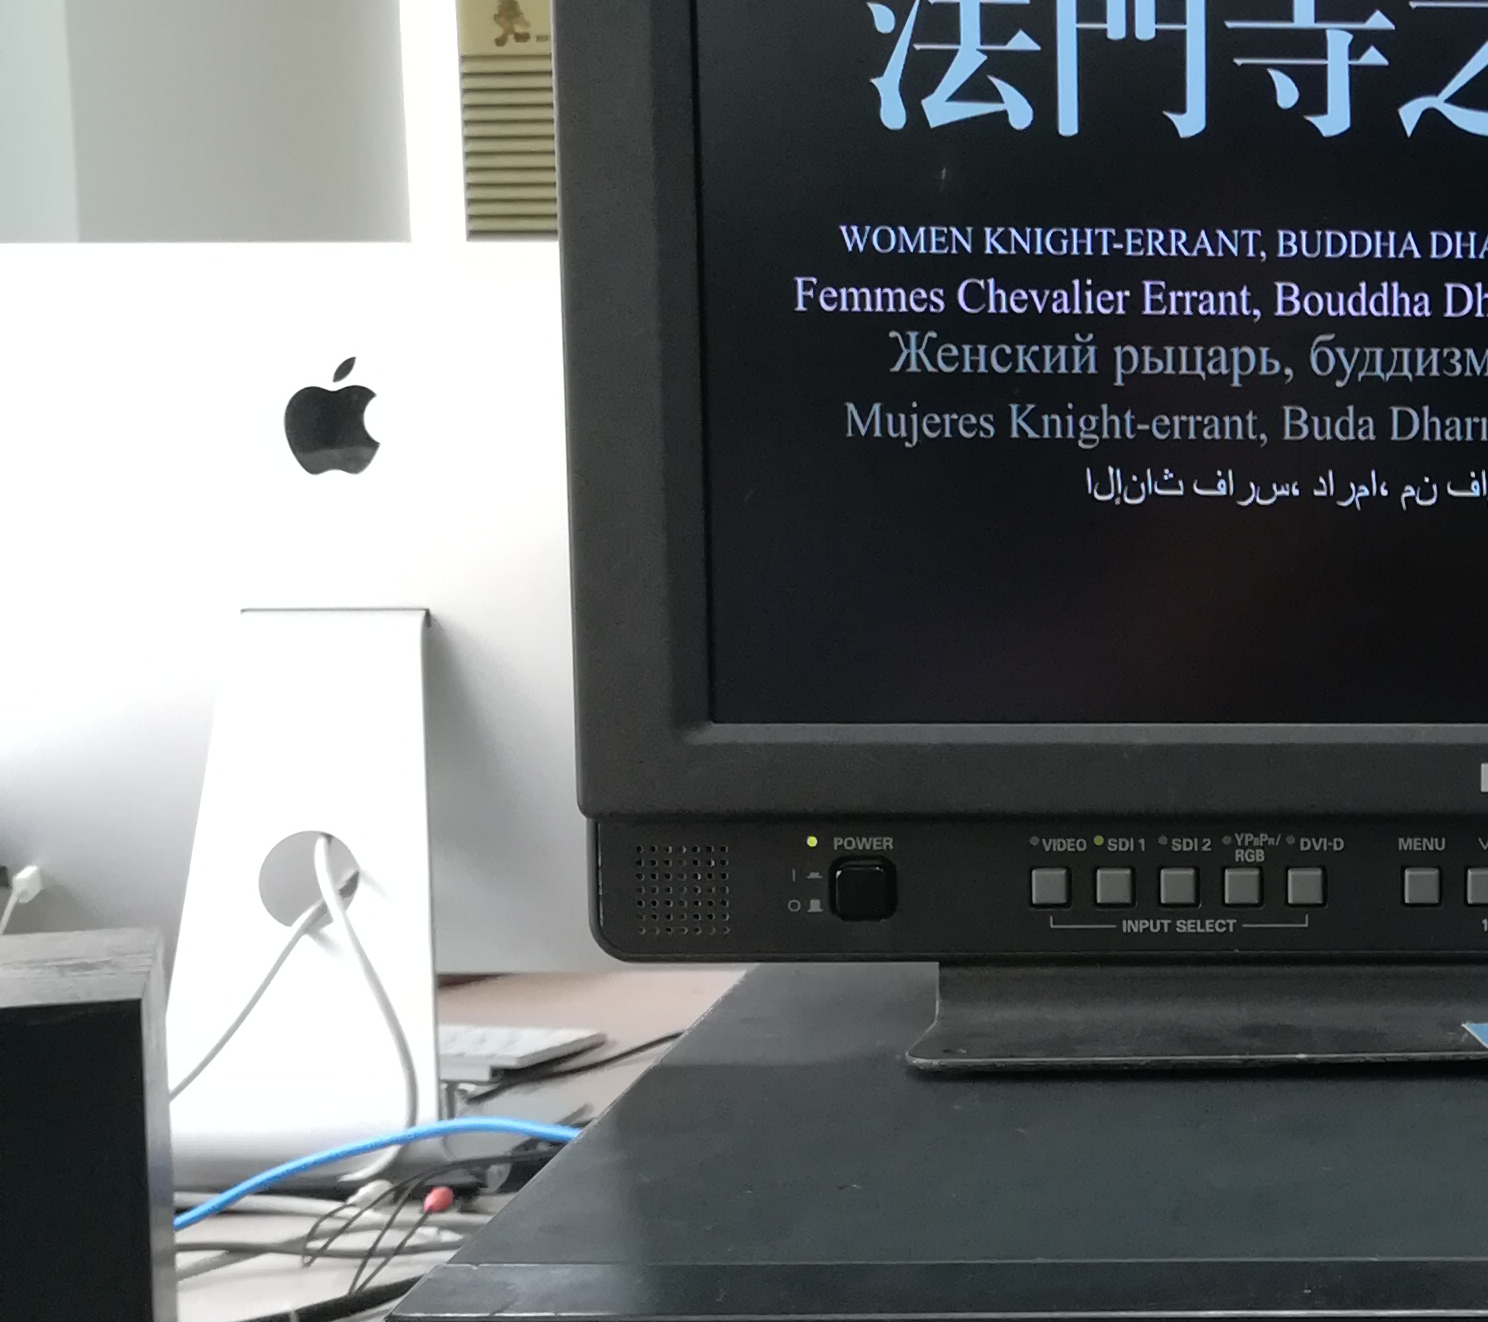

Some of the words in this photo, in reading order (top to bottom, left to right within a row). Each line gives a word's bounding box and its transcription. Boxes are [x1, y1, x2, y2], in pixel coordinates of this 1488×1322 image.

[838, 224, 973, 254] WOMEN
[983, 226, 1268, 262] KNIGHT-ERRANT,
[1276, 228, 1421, 260] BUDDHA
[793, 276, 946, 314] Femmes
[956, 277, 1131, 316] Chevalier
[1140, 280, 1262, 322] Errant,
[1273, 281, 1431, 319] Bouddha
[888, 330, 1099, 376] Женский
[1113, 343, 1295, 387] рыцарь,
[844, 401, 996, 448] Mujeres
[1008, 402, 1270, 449] Knight-errant,
[1282, 405, 1376, 443] Buda
[832, 836, 895, 851] POWER
[1040, 837, 1088, 853] VIDEO
[1299, 837, 1345, 852] DVI-D
[1397, 837, 1447, 852] MENU
[1234, 848, 1266, 864] RGB
[1121, 919, 1172, 934] INPUT
[1175, 919, 1238, 934] SELECT
